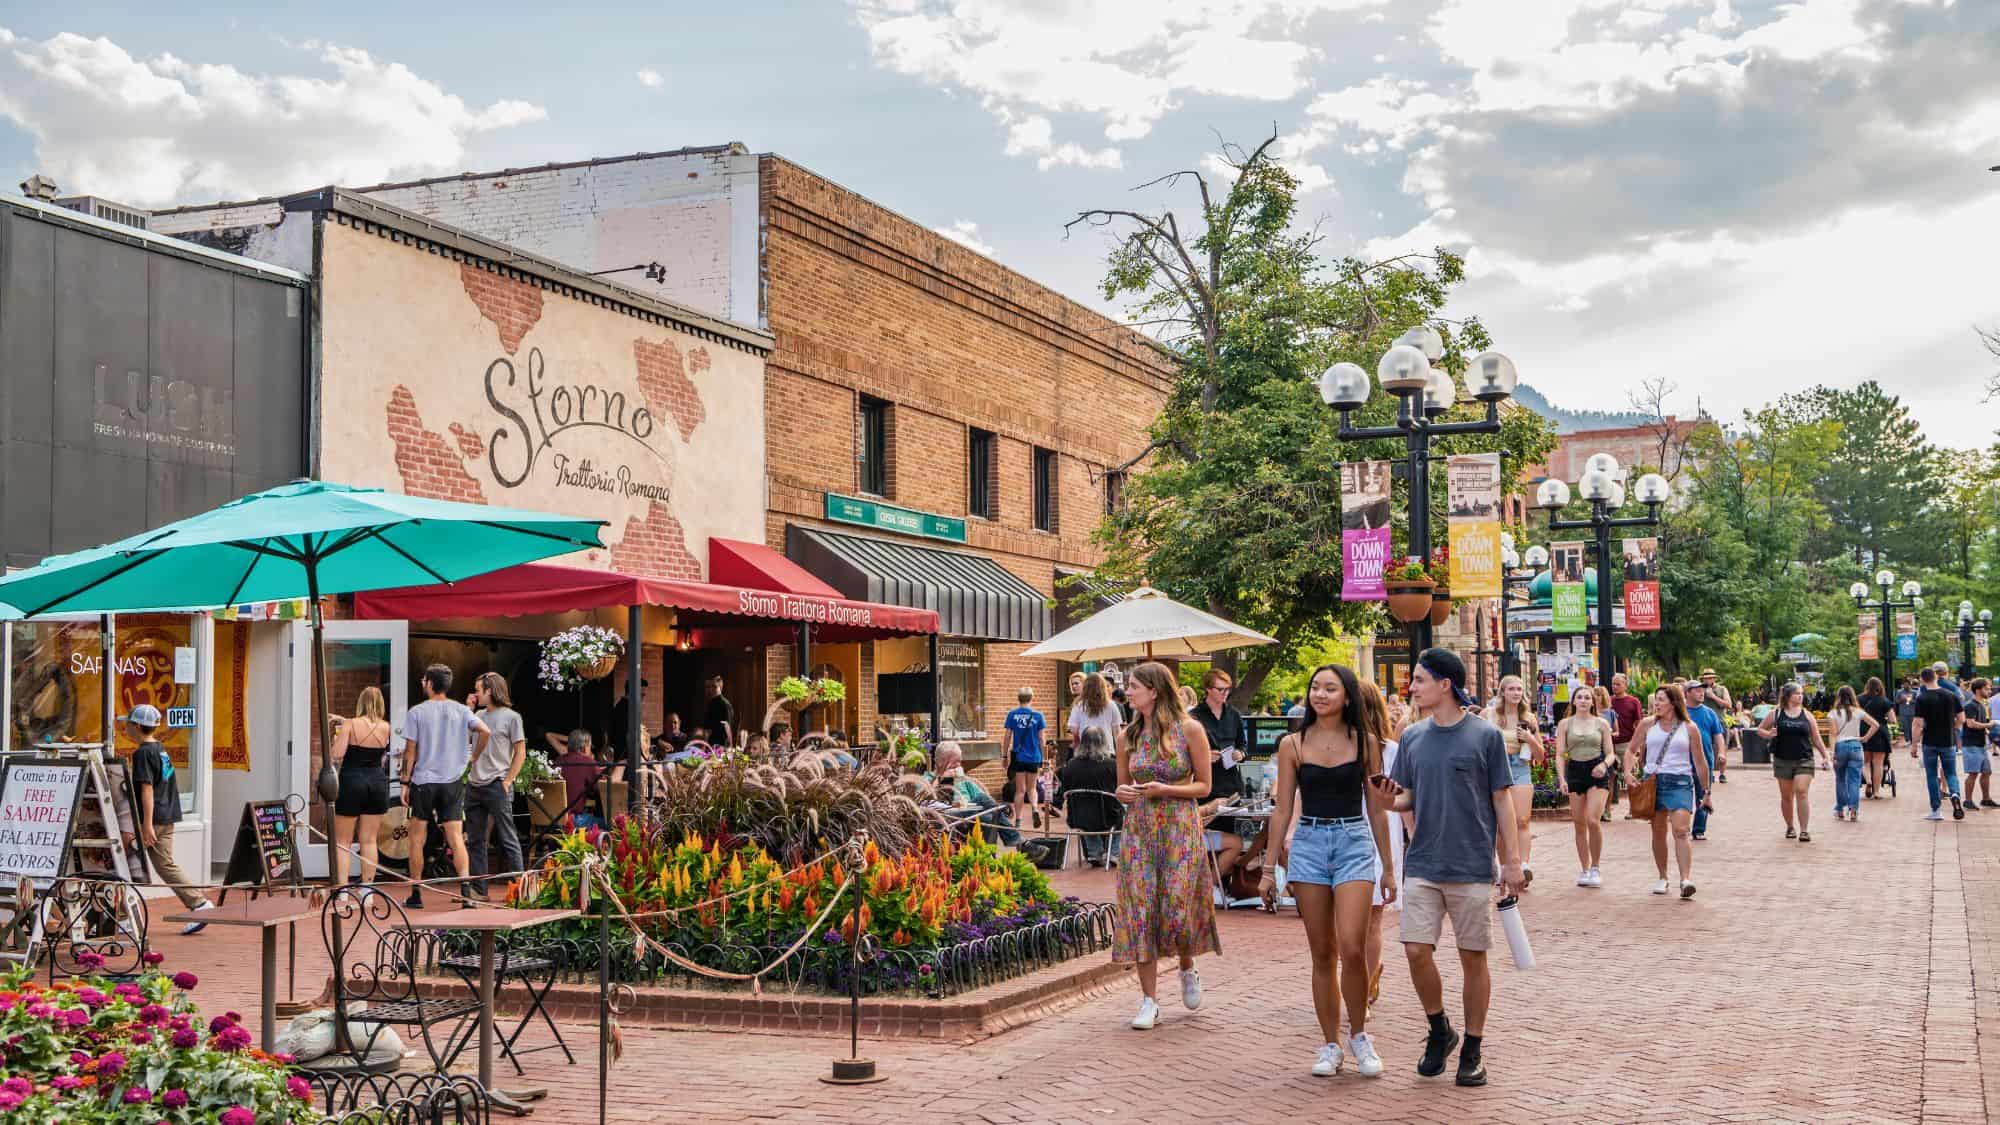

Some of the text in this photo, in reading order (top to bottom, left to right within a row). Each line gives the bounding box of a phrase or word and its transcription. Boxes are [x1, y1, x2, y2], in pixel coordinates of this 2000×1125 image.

[484, 347, 653, 488] Sforno
[553, 453, 671, 502] Trattoria Romana
[1351, 541, 1384, 560] DOWN
[1457, 536, 1493, 554] DOWN
[1352, 559, 1384, 577] TOWN
[1459, 555, 1493, 574] TOWN
[1629, 591, 1654, 603] DOWN
[781, 595, 825, 618] Trattoria
[828, 600, 871, 624] Romana
[1558, 606, 1581, 617] TOWN
[1631, 603, 1655, 615] TOWN
[169, 709, 195, 725] OPEN
[14, 768, 77, 784] Come in for
[24, 789, 57, 803] FREE
[4, 804, 68, 823] SAMPLE
[0, 829, 60, 848] FALAFEL
[7, 853, 56, 870] GYROS
